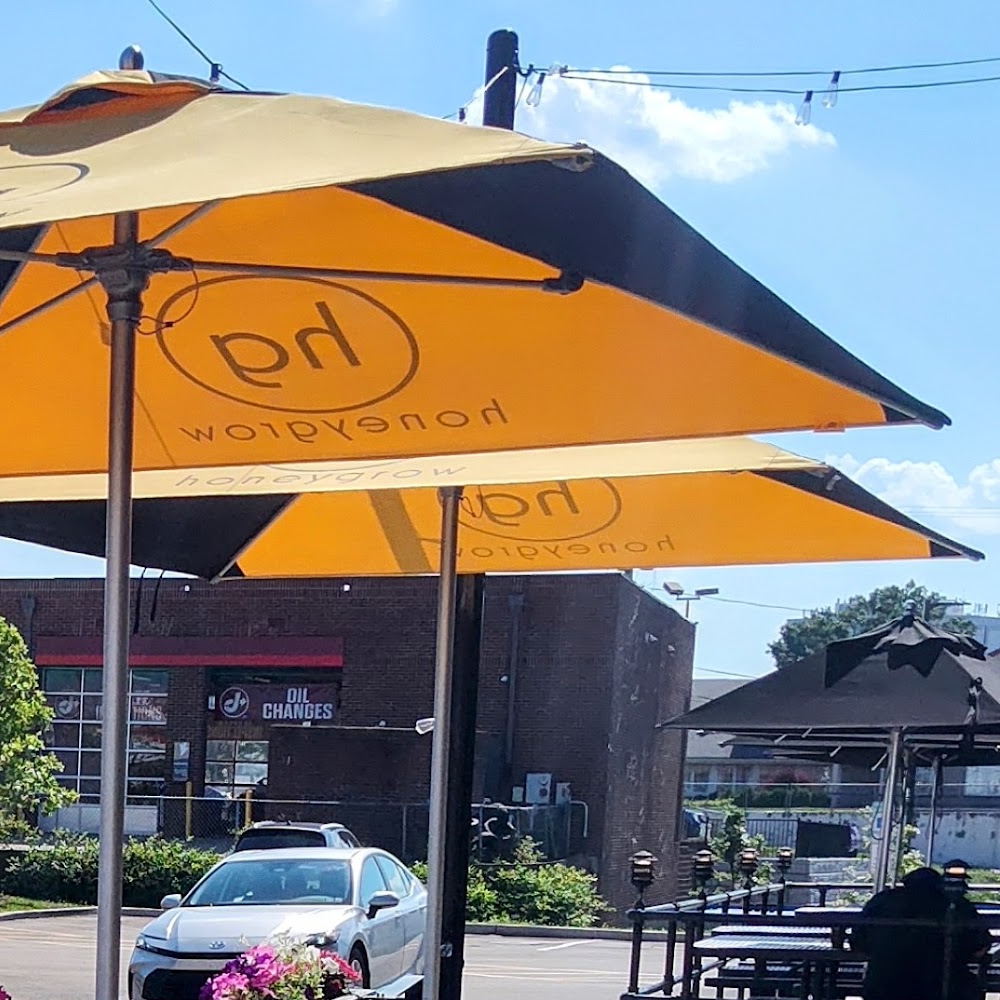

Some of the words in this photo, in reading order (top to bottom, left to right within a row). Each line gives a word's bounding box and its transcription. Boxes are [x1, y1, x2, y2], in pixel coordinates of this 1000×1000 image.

[175, 466, 467, 488] honeygrow
[286, 688, 310, 703] OIL
[262, 703, 333, 719] CHANGES
